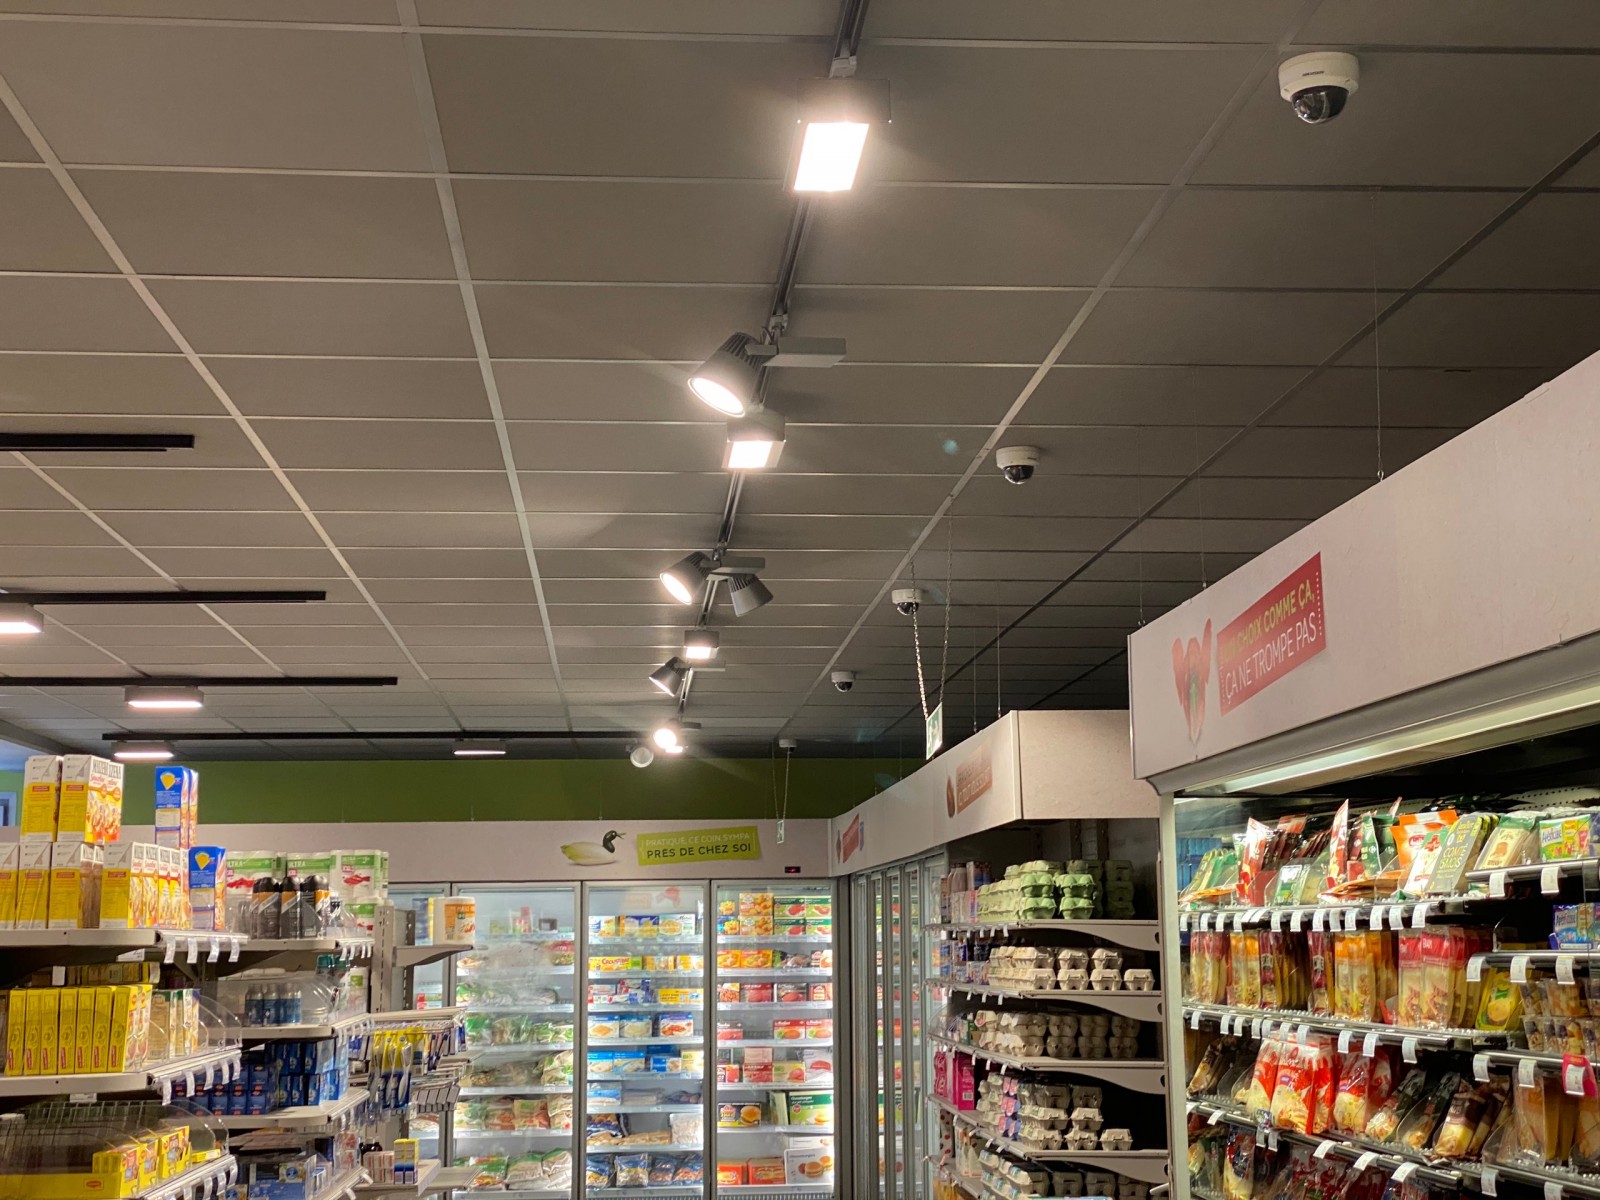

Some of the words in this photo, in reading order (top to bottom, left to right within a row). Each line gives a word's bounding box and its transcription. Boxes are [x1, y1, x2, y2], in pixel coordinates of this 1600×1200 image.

[1237, 616, 1262, 650] CHOIX
[1263, 589, 1296, 632] COMME
[1225, 669, 1238, 704] ÇA
[1238, 657, 1252, 690] NE
[1252, 627, 1294, 679] TROMPE
[1295, 611, 1317, 651] PAS
[679, 847, 695, 857] DE
[698, 844, 728, 855] CHEZ
[732, 843, 751, 853] SOI
[688, 835, 700, 844] CE
[701, 834, 721, 843] COIN
[722, 832, 750, 842] SYMPA
